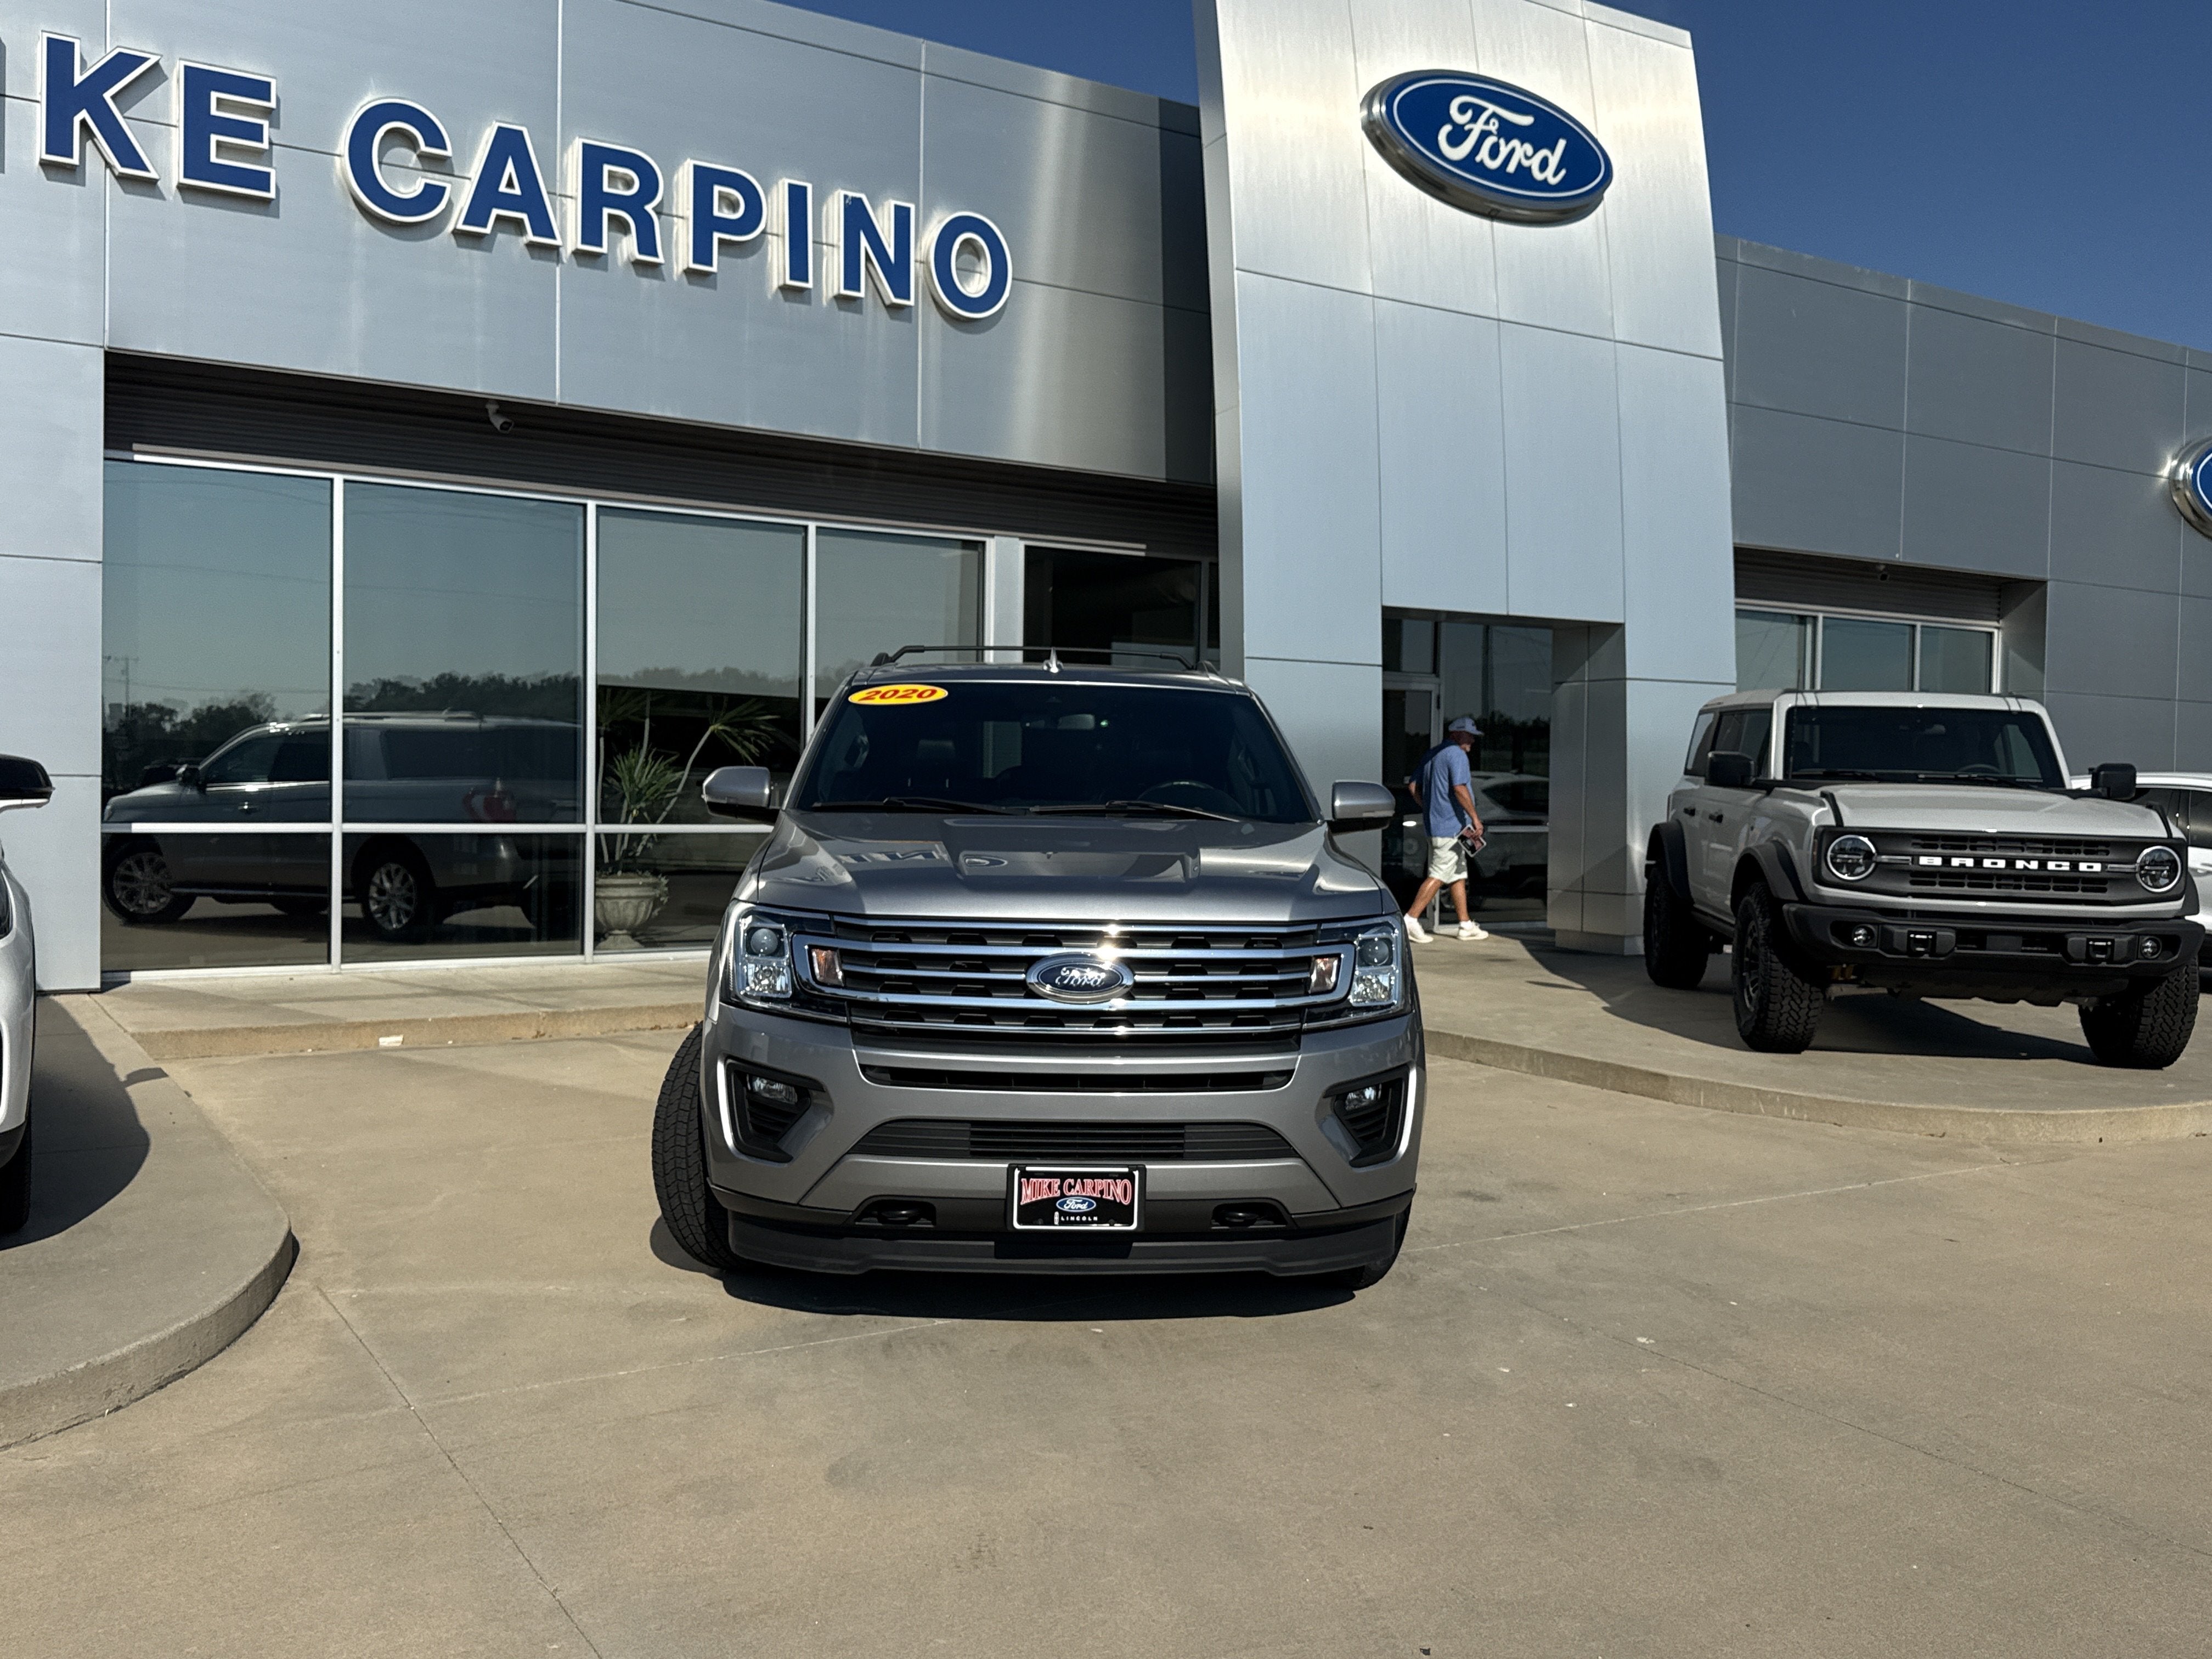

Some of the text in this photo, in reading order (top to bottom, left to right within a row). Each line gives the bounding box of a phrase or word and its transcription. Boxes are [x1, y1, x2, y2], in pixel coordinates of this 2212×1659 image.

[1437, 95, 1567, 185] Ford
[344, 98, 1012, 319] CARPINO
[857, 689, 938, 701] 2020
[1919, 856, 2102, 872] BRONCO
[1055, 966, 1105, 987] Ford
[1020, 1178, 1132, 1205] MIKE CARPINO
[1063, 1199, 1088, 1209] Ford
